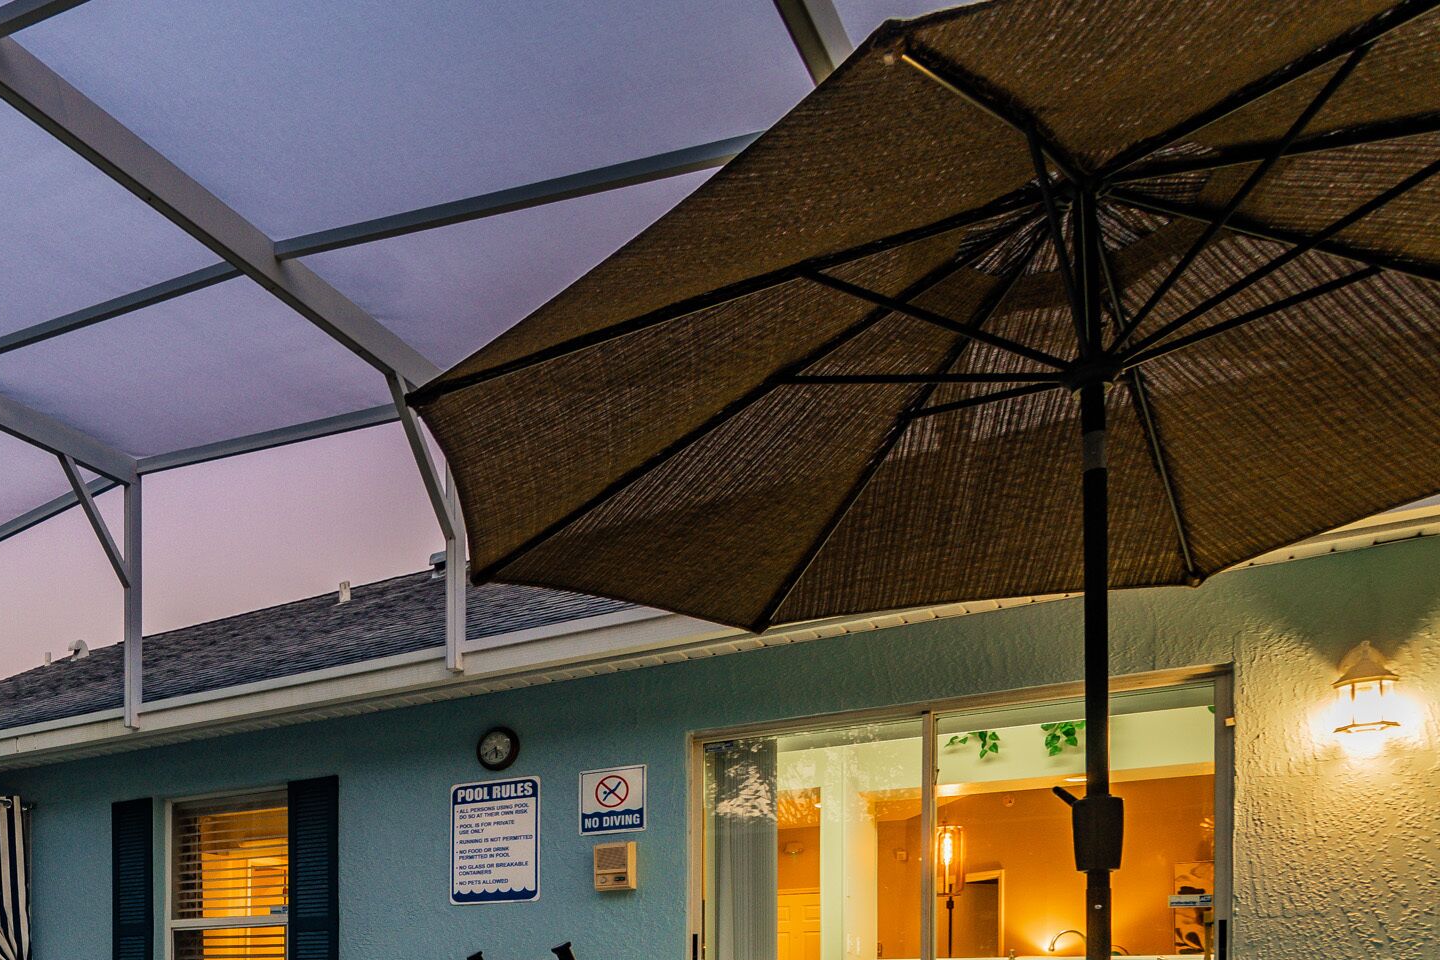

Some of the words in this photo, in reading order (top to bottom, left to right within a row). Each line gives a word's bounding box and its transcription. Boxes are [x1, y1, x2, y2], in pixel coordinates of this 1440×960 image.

[458, 787, 490, 802] POOL
[492, 782, 532, 798] RULES
[585, 818, 599, 828] NO
[603, 814, 640, 826] DIVING
